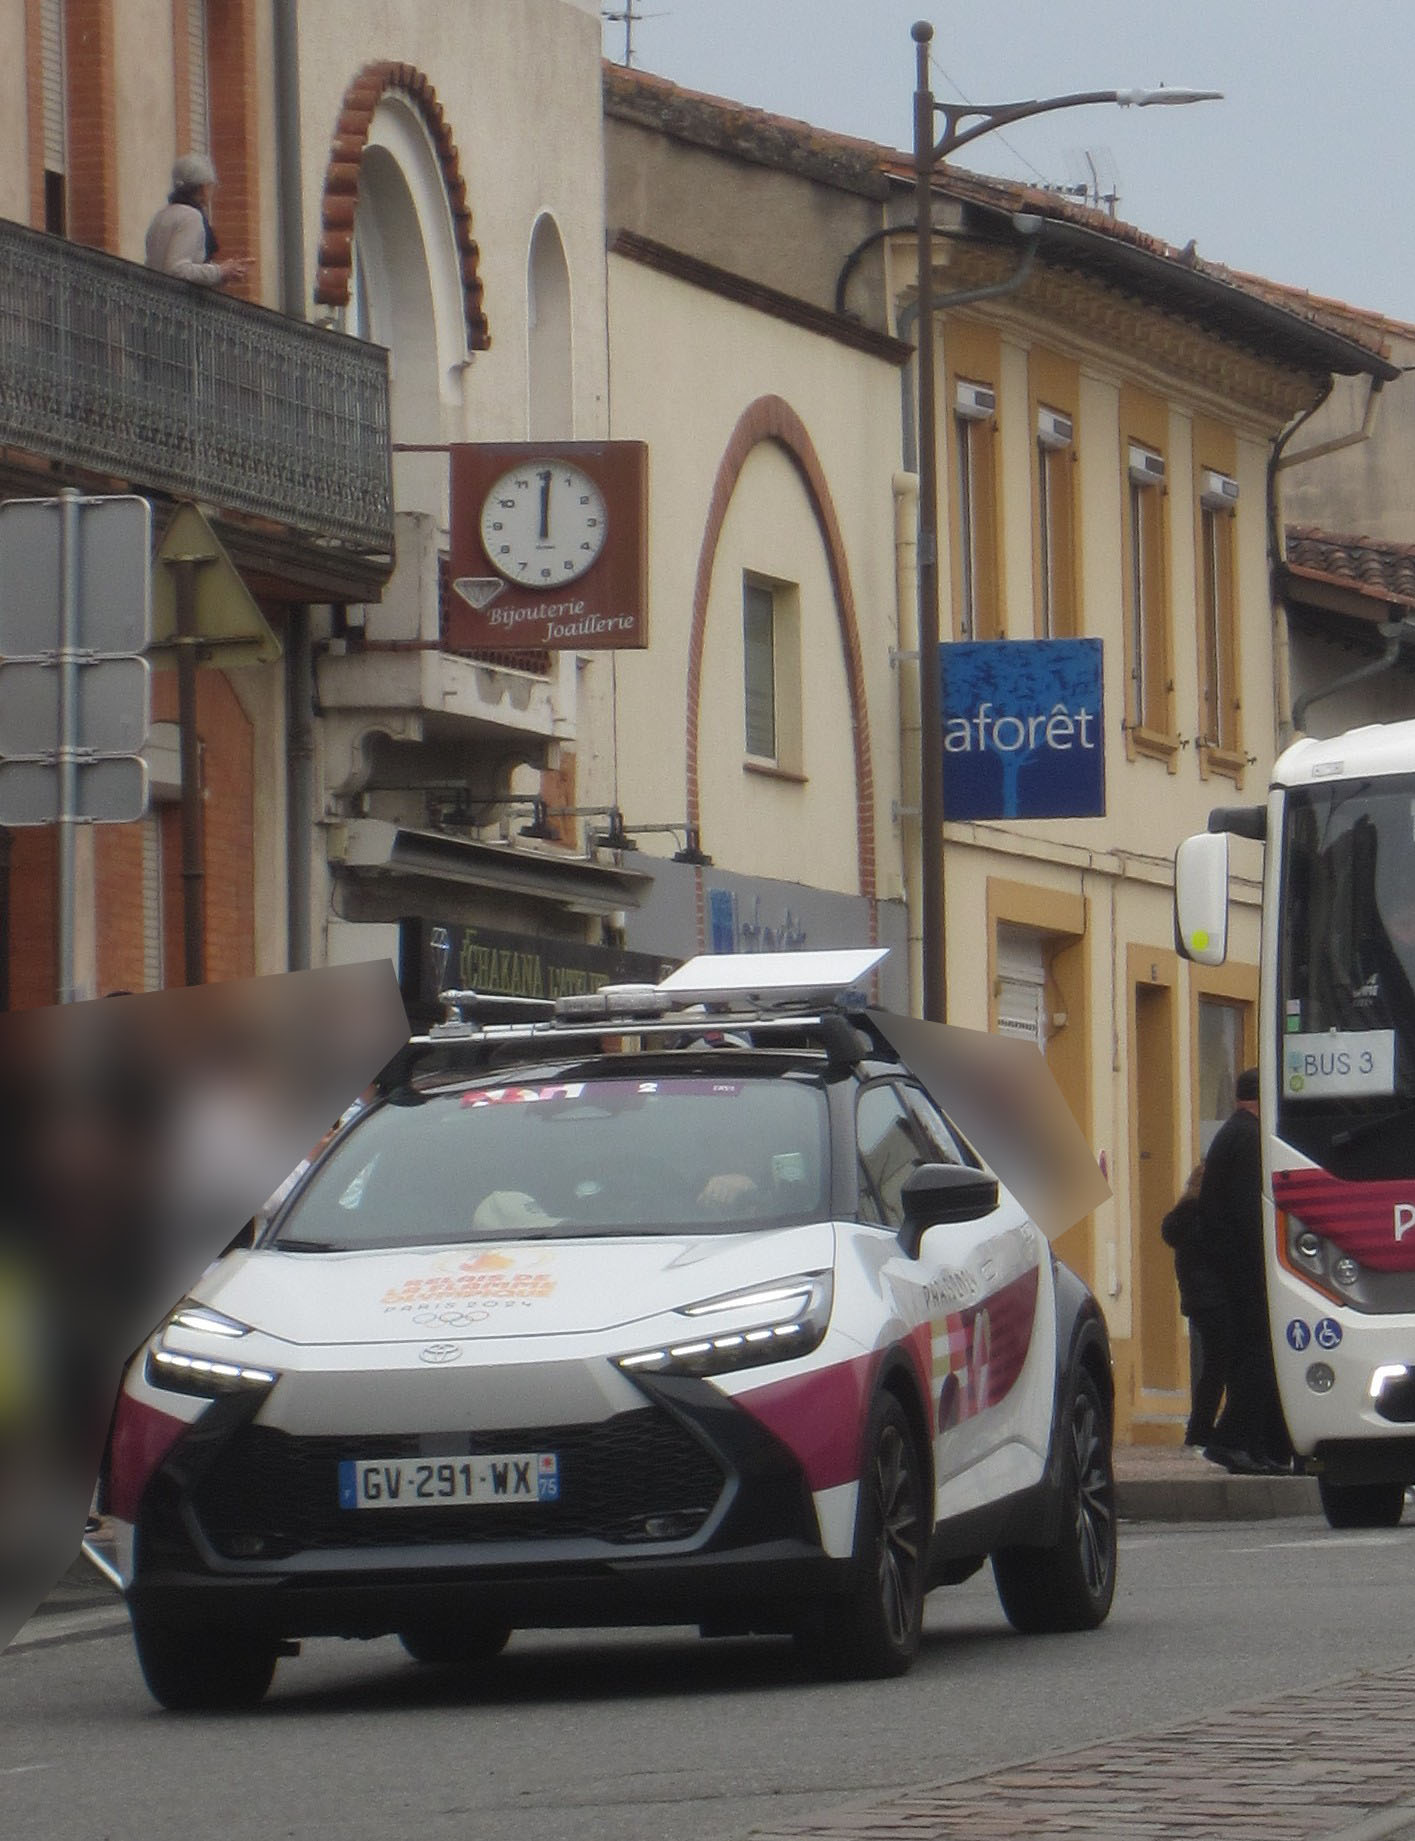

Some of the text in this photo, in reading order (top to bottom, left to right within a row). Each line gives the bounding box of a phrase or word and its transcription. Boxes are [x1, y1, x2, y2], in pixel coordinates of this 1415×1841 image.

[586, 518, 597, 528] 3
[580, 541, 590, 551] 4
[517, 562, 528, 571] 7
[489, 600, 585, 630] Bijouterie
[541, 613, 635, 643] Joaillerie
[944, 703, 1095, 752] aforêt
[1304, 1050, 1374, 1077] BUS 3
[637, 1083, 658, 1093] 2
[362, 1460, 531, 1501] GV-291-WX
[539, 1477, 557, 1495] 75
